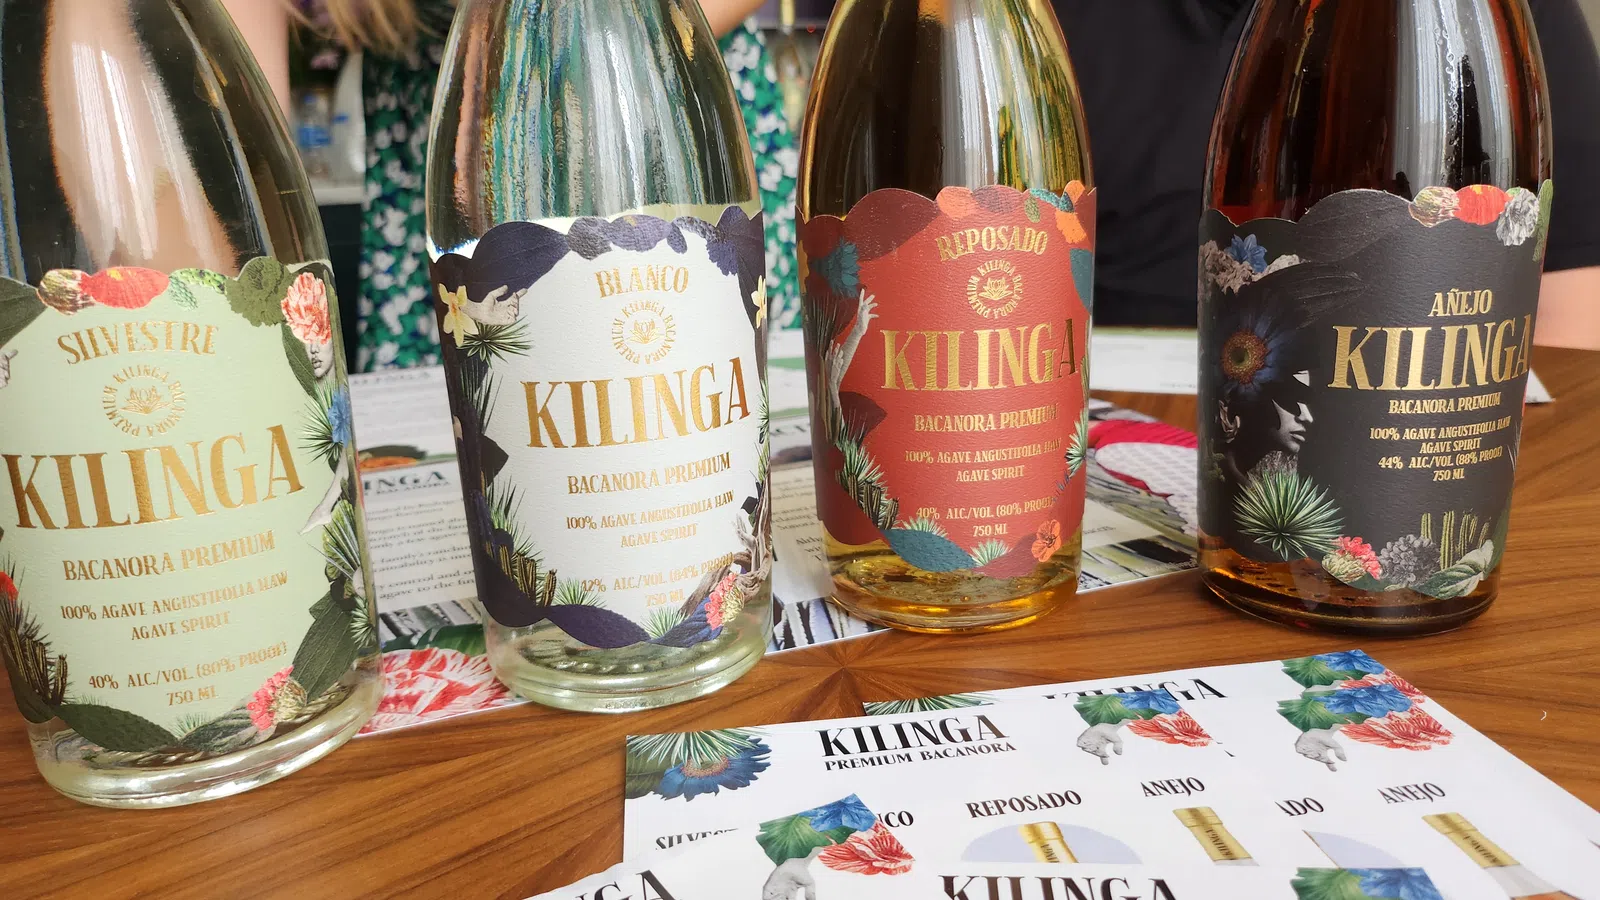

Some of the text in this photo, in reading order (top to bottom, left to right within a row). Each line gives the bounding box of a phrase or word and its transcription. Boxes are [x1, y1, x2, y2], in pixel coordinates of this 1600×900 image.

[934, 225, 1048, 262] REPOSADO
[593, 264, 689, 298] BLANCO
[977, 259, 1016, 276] KILINGA
[1428, 288, 1493, 317] AÑEJO
[57, 320, 219, 365] SILVESTRE
[880, 318, 1079, 391] KILINGA
[1327, 314, 1532, 391] KILINGA
[112, 365, 169, 384] KILINGA
[520, 356, 752, 449] KILINGA
[1388, 391, 1502, 414] BACANORA PREMIUM
[914, 403, 1058, 432] BACANORA PREMIUM
[1370, 427, 1400, 441] 100%
[1402, 427, 1437, 440] AGAVE
[1438, 420, 1496, 439] ANGUSTIFOLIA
[905, 450, 934, 464] 100%
[937, 452, 971, 464] AGAVE
[974, 444, 1041, 463] ANGUSTIFOLIA
[1419, 437, 1482, 454] AGAVE SPIRIT
[2, 424, 305, 530] KILINGA
[567, 451, 731, 494] BACANORA PREMIUM
[956, 465, 1025, 483] AGAVE SPIRIT
[1378, 456, 1404, 469] 44%
[1433, 467, 1465, 481] 750 ML
[566, 490, 735, 531] 100% AGAVE ANGUSTIFOLIA HAW
[916, 507, 940, 520] 40%
[996, 503, 1022, 518] (80%
[620, 523, 699, 548] AGAVE SPIRIT
[973, 523, 1008, 537] 750 ML
[62, 530, 276, 581] BACANORA PREMIUM
[60, 605, 97, 620] 100%
[101, 602, 148, 619] AGAVE
[152, 582, 255, 614] ANGUSTIFOLIA
[131, 611, 230, 641] AGAVE SPIRIT
[88, 674, 119, 689] 40%
[196, 658, 236, 678] (80%
[166, 685, 218, 706] 750 ML
[815, 714, 1010, 757] KILINGA
[824, 742, 1017, 771] PREMIUM BACANORA
[1140, 776, 1206, 797] ANEJO
[1377, 782, 1446, 804] ANEJO
[965, 789, 1082, 819] REPOSADO
